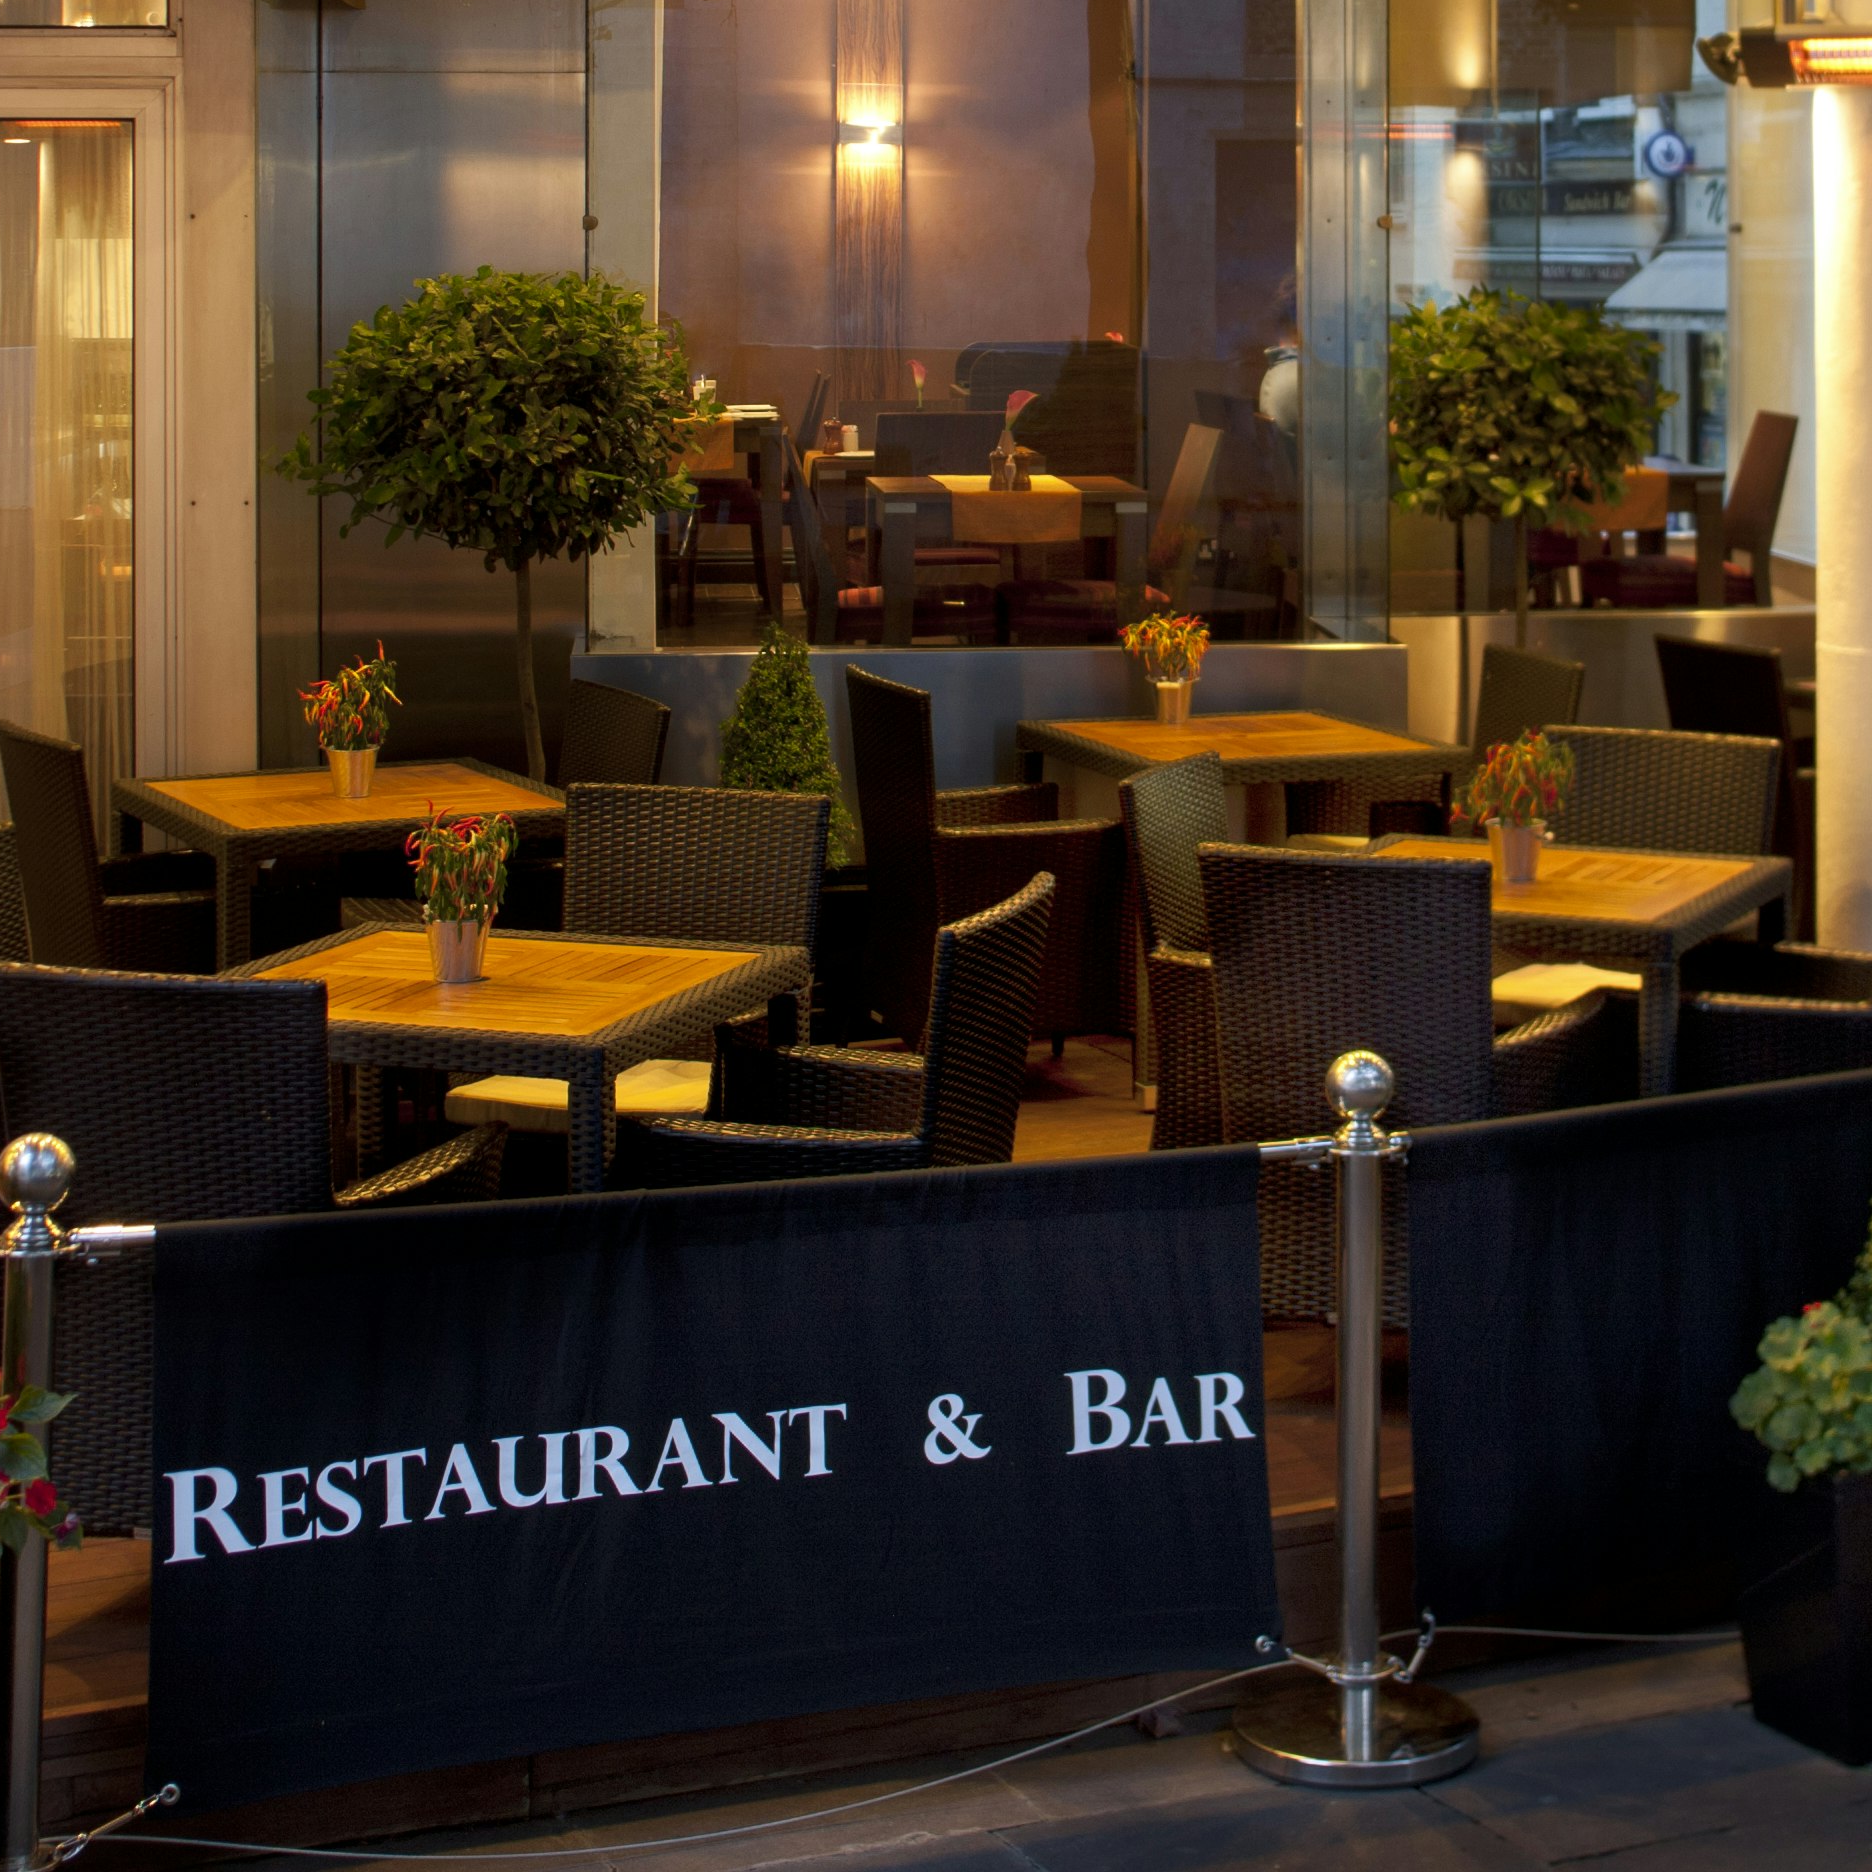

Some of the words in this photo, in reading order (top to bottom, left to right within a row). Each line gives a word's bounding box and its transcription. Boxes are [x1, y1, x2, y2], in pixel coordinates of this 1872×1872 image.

[162, 1403, 848, 1565] RESTAURANT
[922, 1392, 993, 1466] &
[1062, 1367, 1257, 1456] BAR
